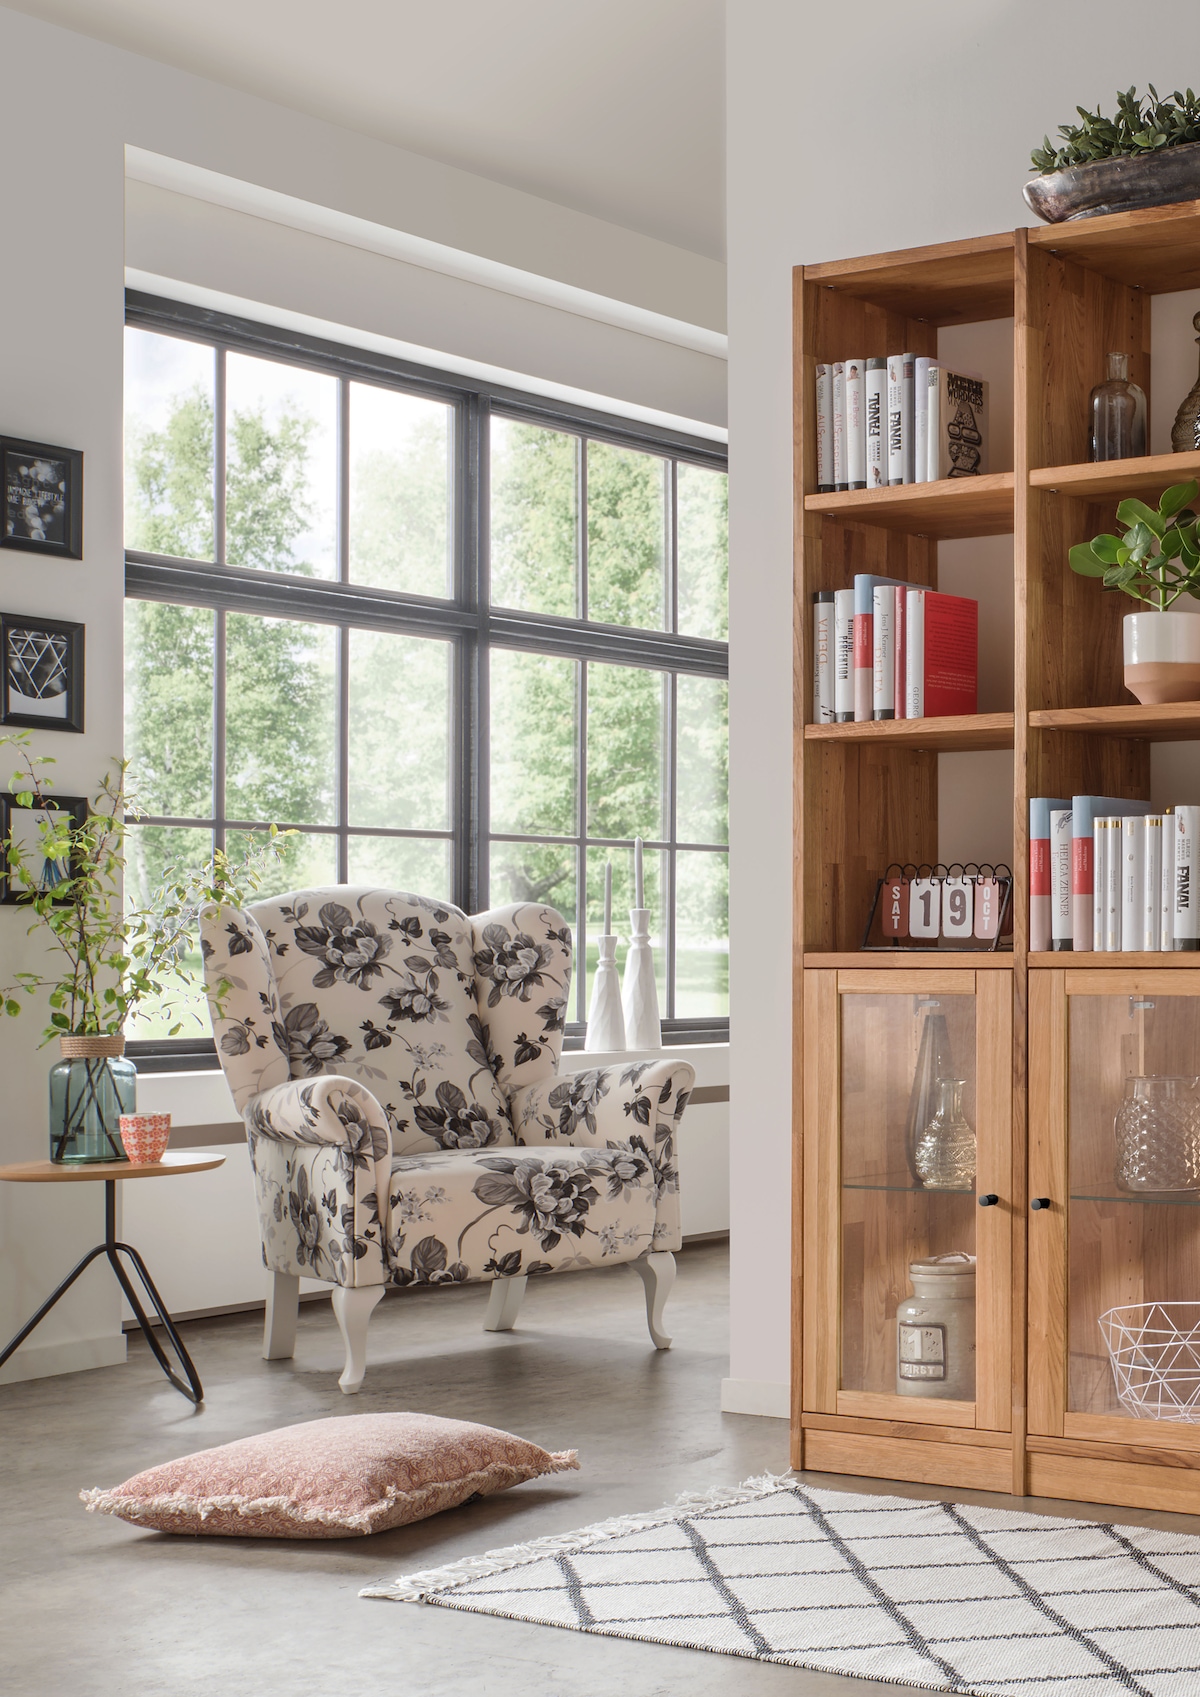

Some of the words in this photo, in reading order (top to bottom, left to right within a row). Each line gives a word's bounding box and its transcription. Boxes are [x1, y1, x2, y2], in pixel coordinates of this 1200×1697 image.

[868, 392, 880, 437] FANAL
[890, 410, 902, 456] FANAL
[818, 618, 828, 664] DELTA
[1060, 844, 1069, 878] HELGA
[892, 886, 900, 930] SAT
[982, 886, 991, 930] OCT
[1060, 880, 1069, 916] ZEINER
[1176, 866, 1190, 913] FANAL
[908, 1329, 922, 1360] 1
[904, 1365, 936, 1376] FIRST
